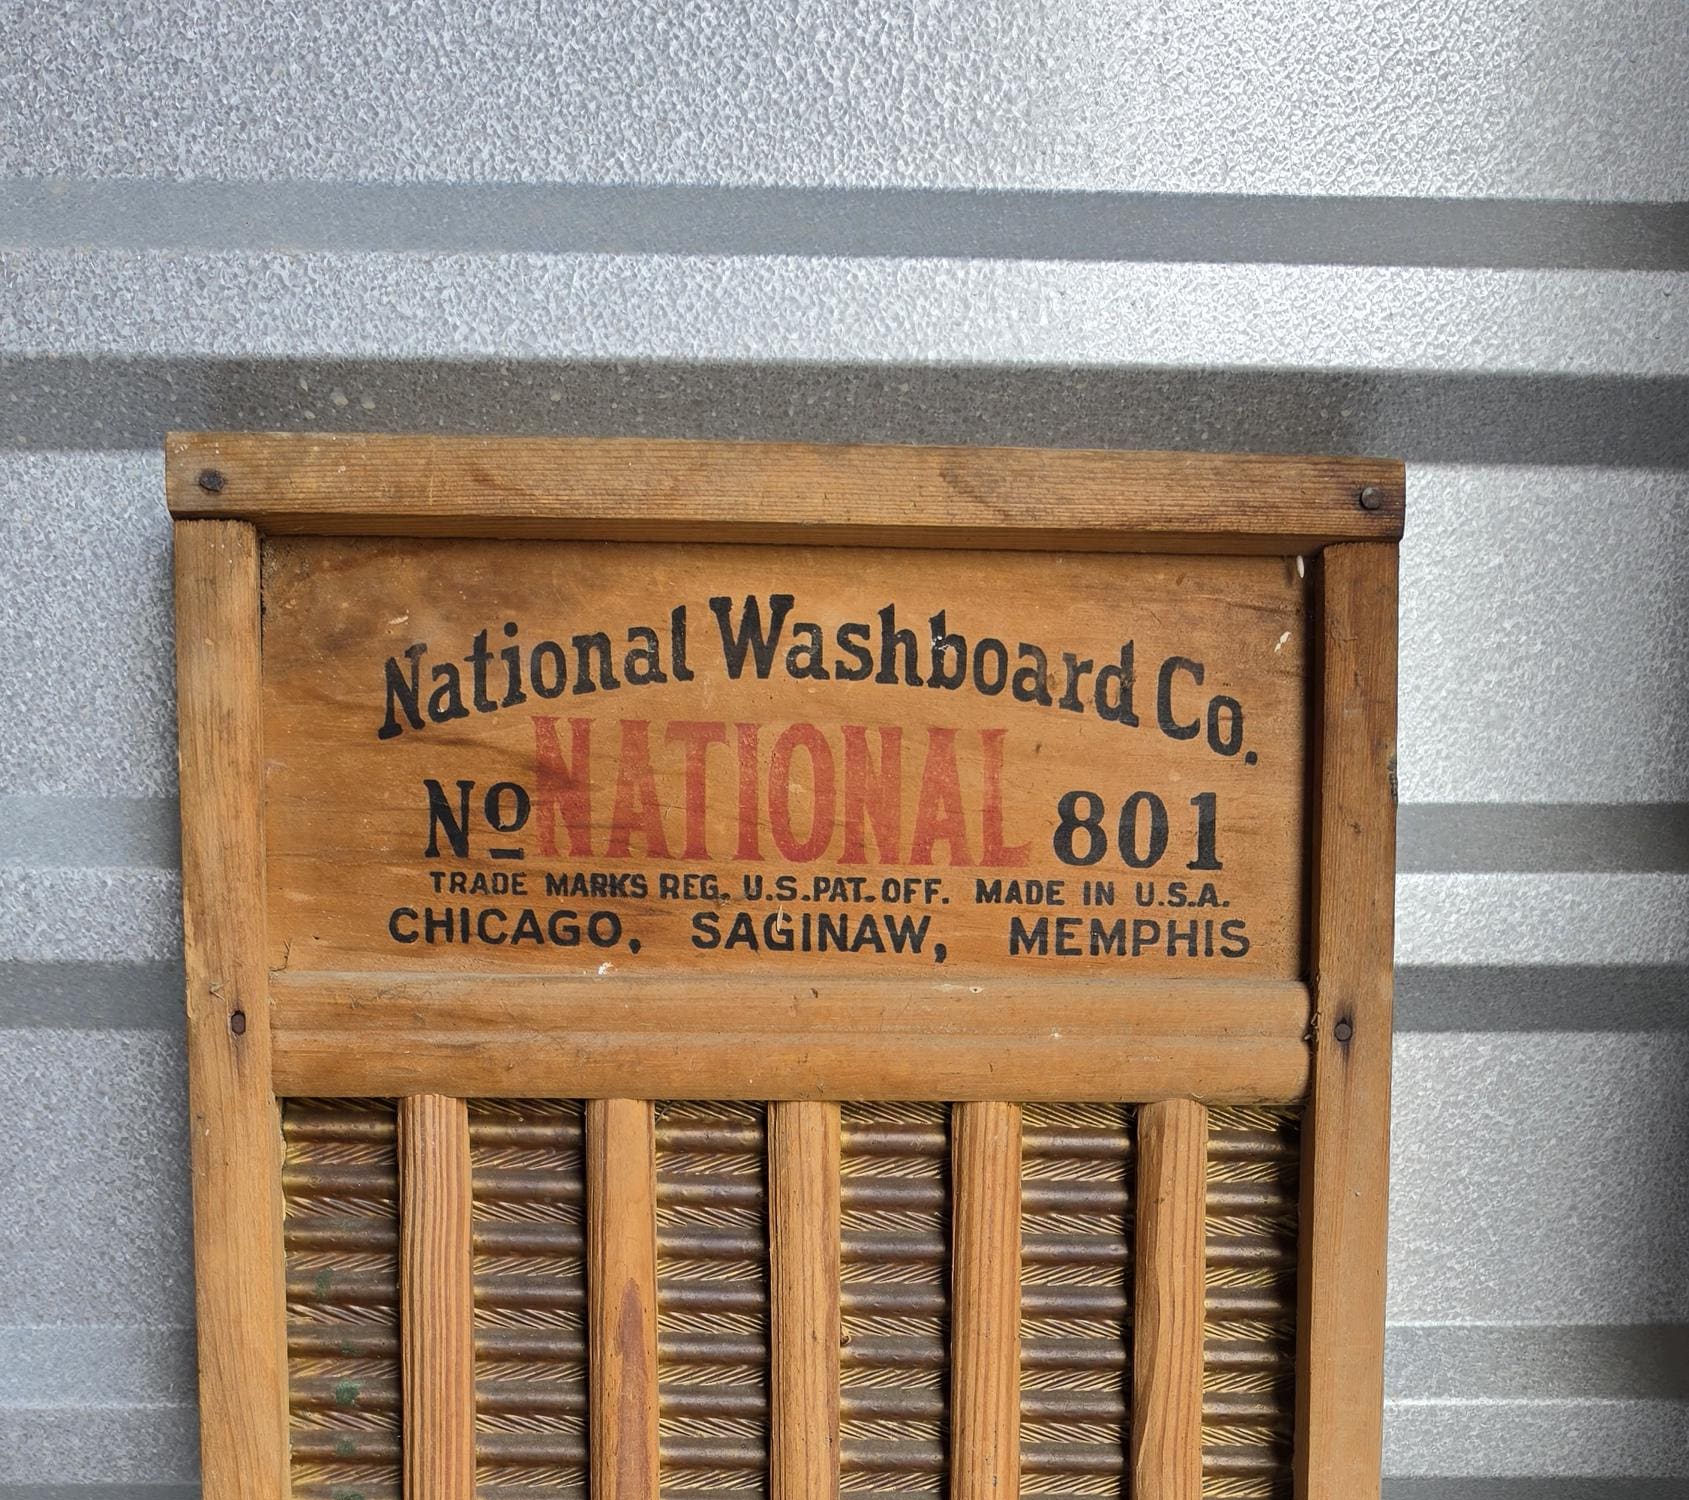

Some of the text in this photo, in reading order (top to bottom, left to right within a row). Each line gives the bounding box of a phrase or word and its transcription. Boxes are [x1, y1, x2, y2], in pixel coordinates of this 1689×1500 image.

[378, 594, 1258, 766] National Washboard Co.
[531, 715, 1032, 869] NATIONAL
[1052, 790, 1223, 871] 801
[388, 907, 1251, 963] CHICAGO, SAGINAW, MEMPHIS
[430, 871, 527, 896] TRADE
[545, 873, 649, 899] MARKS
[659, 874, 731, 901] REG.
[975, 878, 1064, 905] MADE
[1082, 881, 1115, 906] IN
[1135, 882, 1231, 908] U.S.A.
